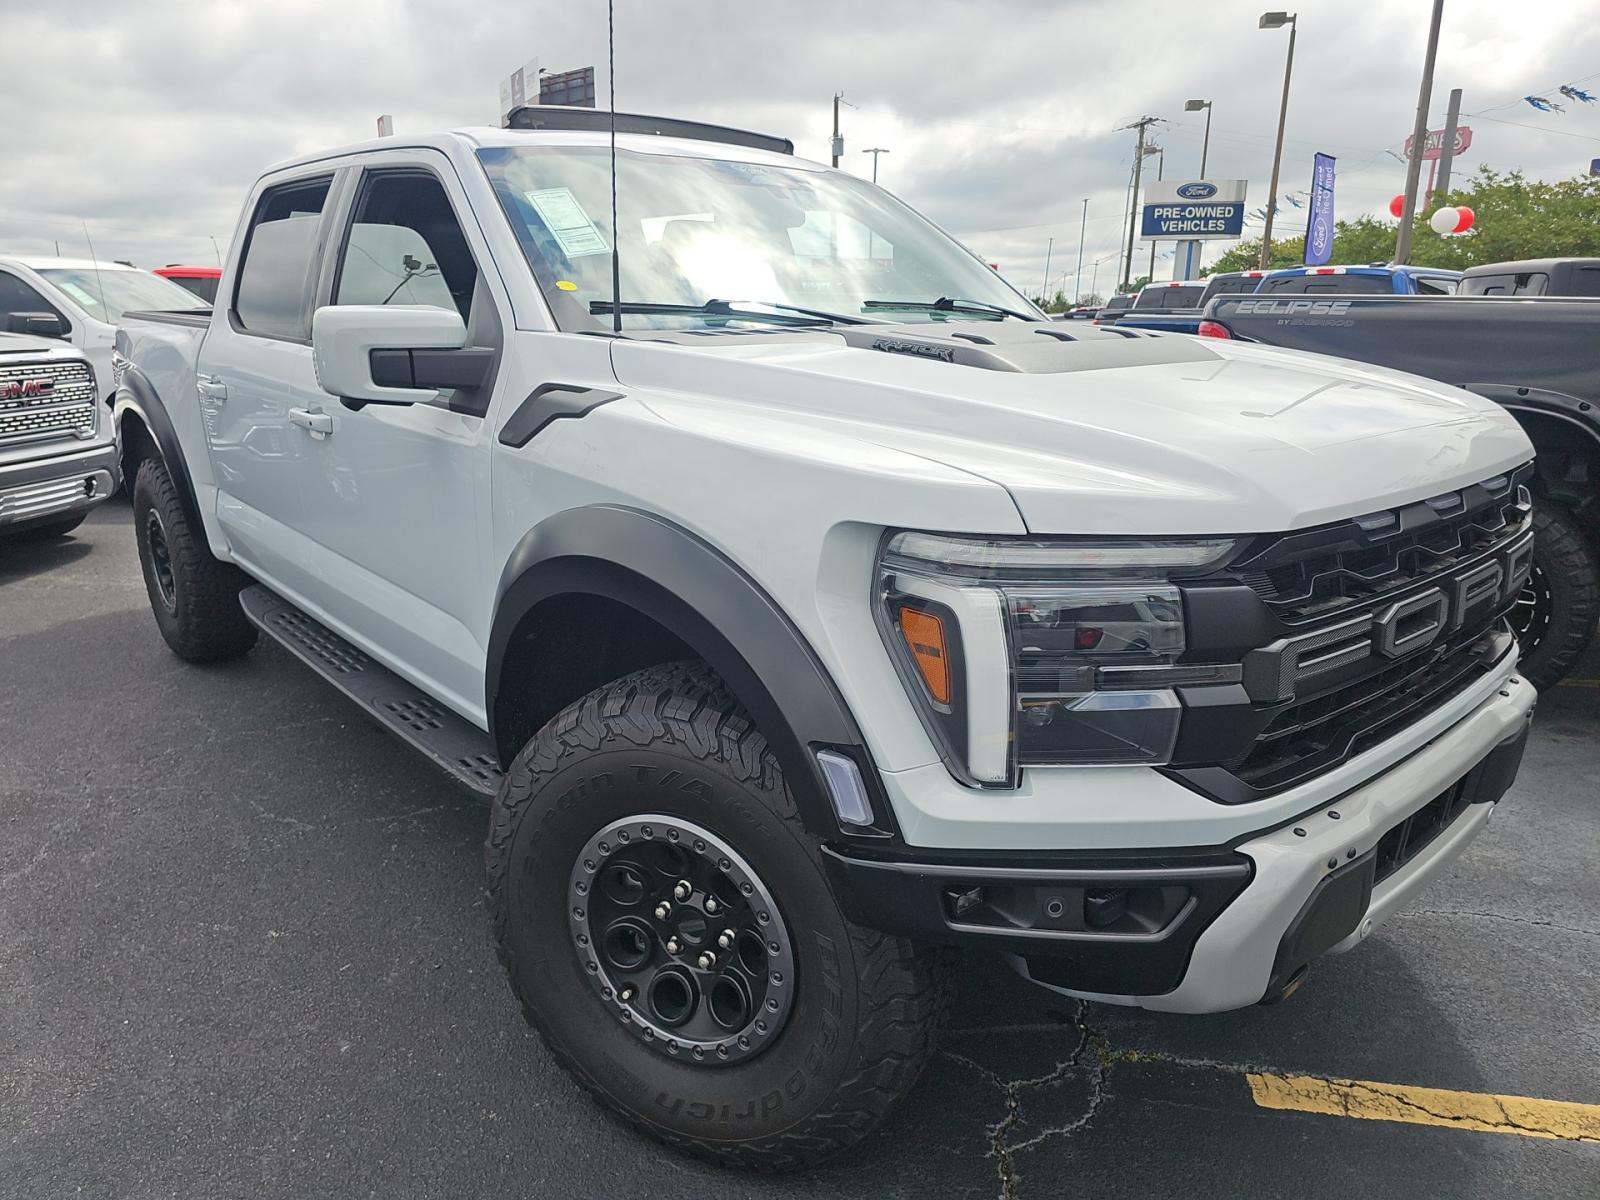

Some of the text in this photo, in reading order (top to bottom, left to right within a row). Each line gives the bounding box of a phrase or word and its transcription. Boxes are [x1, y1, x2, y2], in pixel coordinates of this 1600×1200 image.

[1153, 206, 1234, 219] PRE-OWNED
[1160, 220, 1226, 232] VEHICLES
[1313, 226, 1326, 249] Ford
[1235, 300, 1352, 315] ECLIPSE
[1258, 530, 1534, 702] FORD
